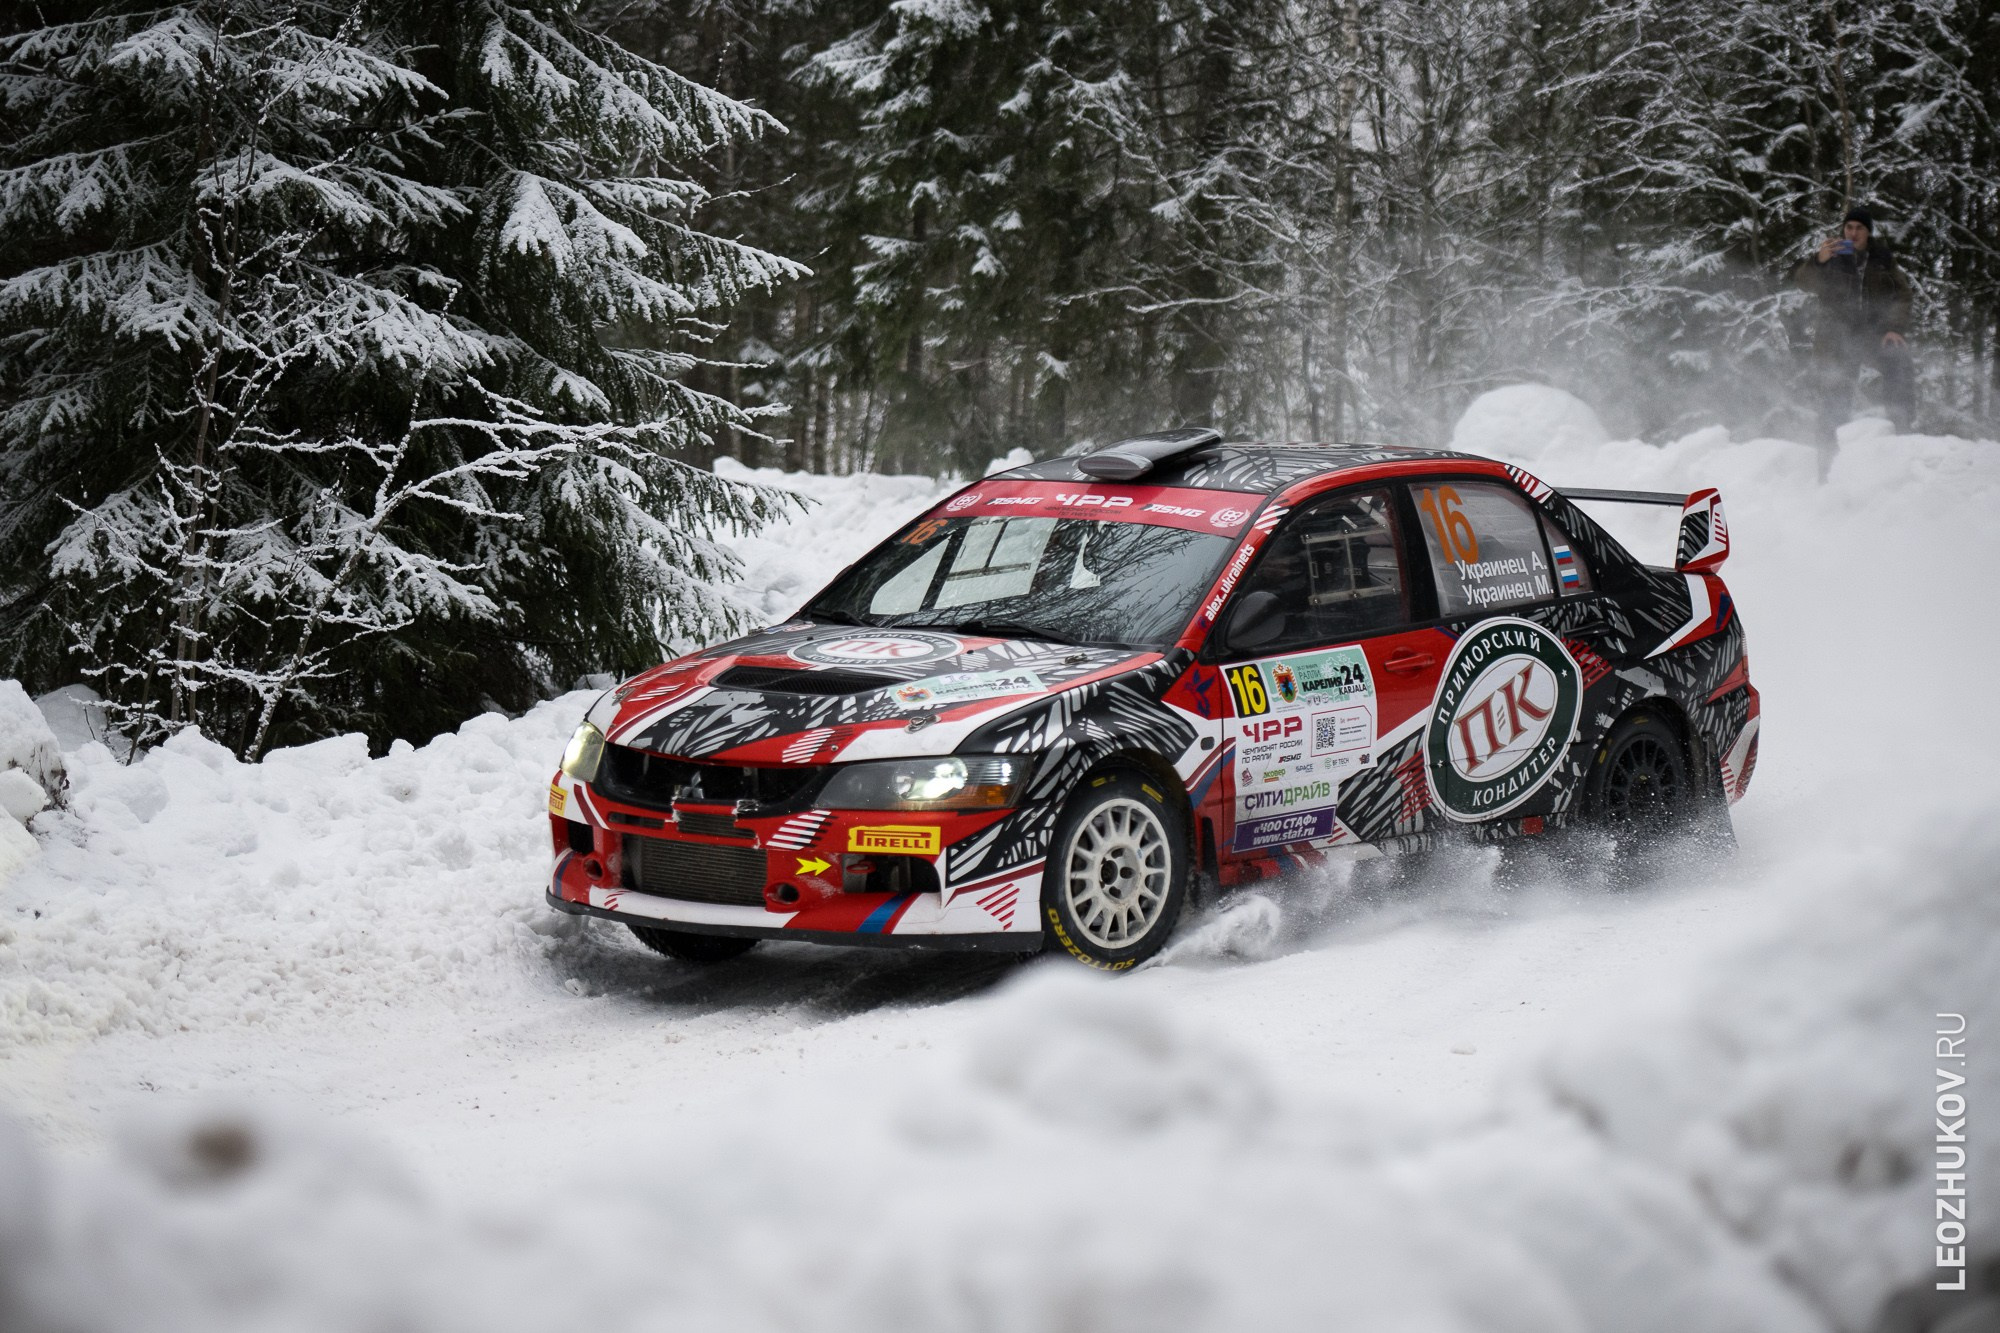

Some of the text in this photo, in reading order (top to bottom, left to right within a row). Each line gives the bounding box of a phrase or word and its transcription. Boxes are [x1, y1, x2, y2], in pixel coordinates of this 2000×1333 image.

[1140, 503, 1206, 518] RSMG
[901, 518, 949, 545] 16
[1420, 485, 1479, 565] 16
[1455, 551, 1548, 583] Украинец А.
[1205, 543, 1255, 621] alex_ukrainets
[1462, 574, 1555, 609] Украинец М.
[1299, 669, 1322, 680] РАЛЛИ
[1302, 676, 1344, 692] КАРЕЛИЯ
[1438, 630, 1541, 725] ПРИМОРСКИЙ
[1230, 665, 1267, 716] 16
[1339, 684, 1368, 696] KARJALA
[1242, 716, 1303, 743] ЧРР
[1454, 659, 1553, 775] ПК
[1242, 739, 1303, 756] ЧЕМПИОНАТ РОССИИ
[1278, 752, 1302, 763] RSMG
[1472, 736, 1557, 807] КОНДИТЕР
[1244, 781, 1331, 810] СИТИДРАЙВ
[1283, 814, 1318, 830] СТАФ»
[856, 829, 932, 849] PIRELLI
[1253, 826, 1316, 846] www.staf.ru
[1048, 907, 1136, 972] SOTTOZERO
